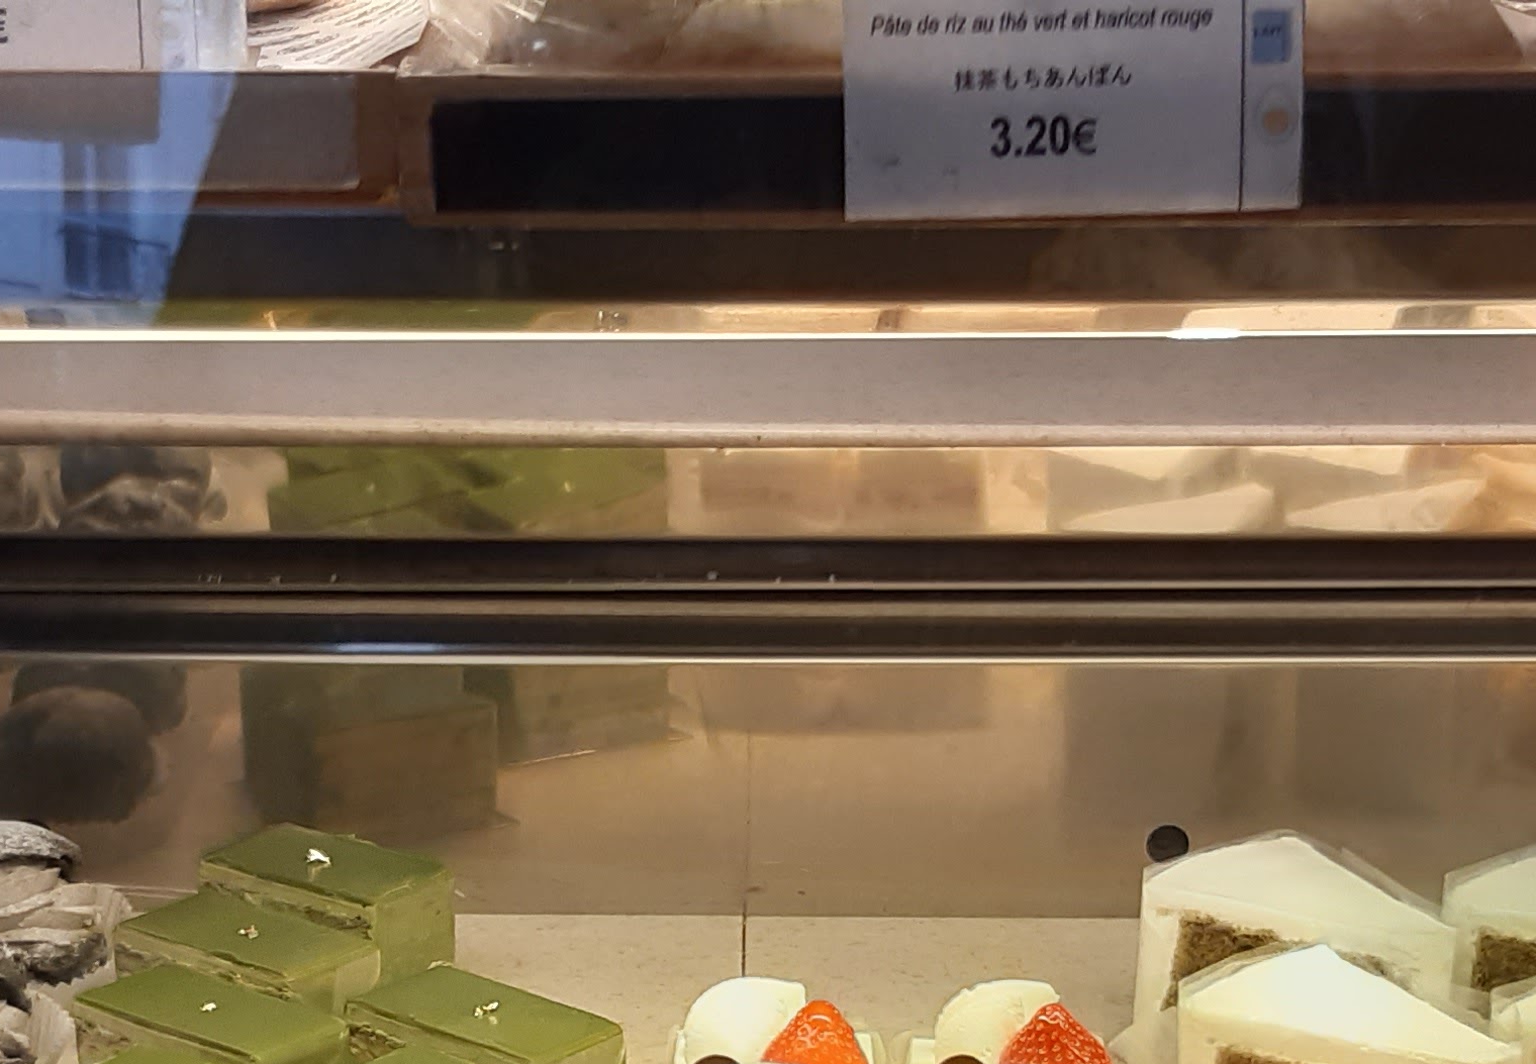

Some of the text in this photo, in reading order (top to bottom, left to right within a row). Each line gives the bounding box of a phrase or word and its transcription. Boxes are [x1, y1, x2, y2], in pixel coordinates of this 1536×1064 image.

[870, 15, 911, 36] Pâte
[916, 15, 939, 35] de
[944, 14, 967, 34] riz
[971, 17, 995, 33] au
[1032, 11, 1067, 32] vert
[1071, 11, 1091, 31] et
[1095, 9, 1156, 30] haricot
[1160, 8, 1214, 31] rouge
[989, 114, 1098, 159] 3.20€
